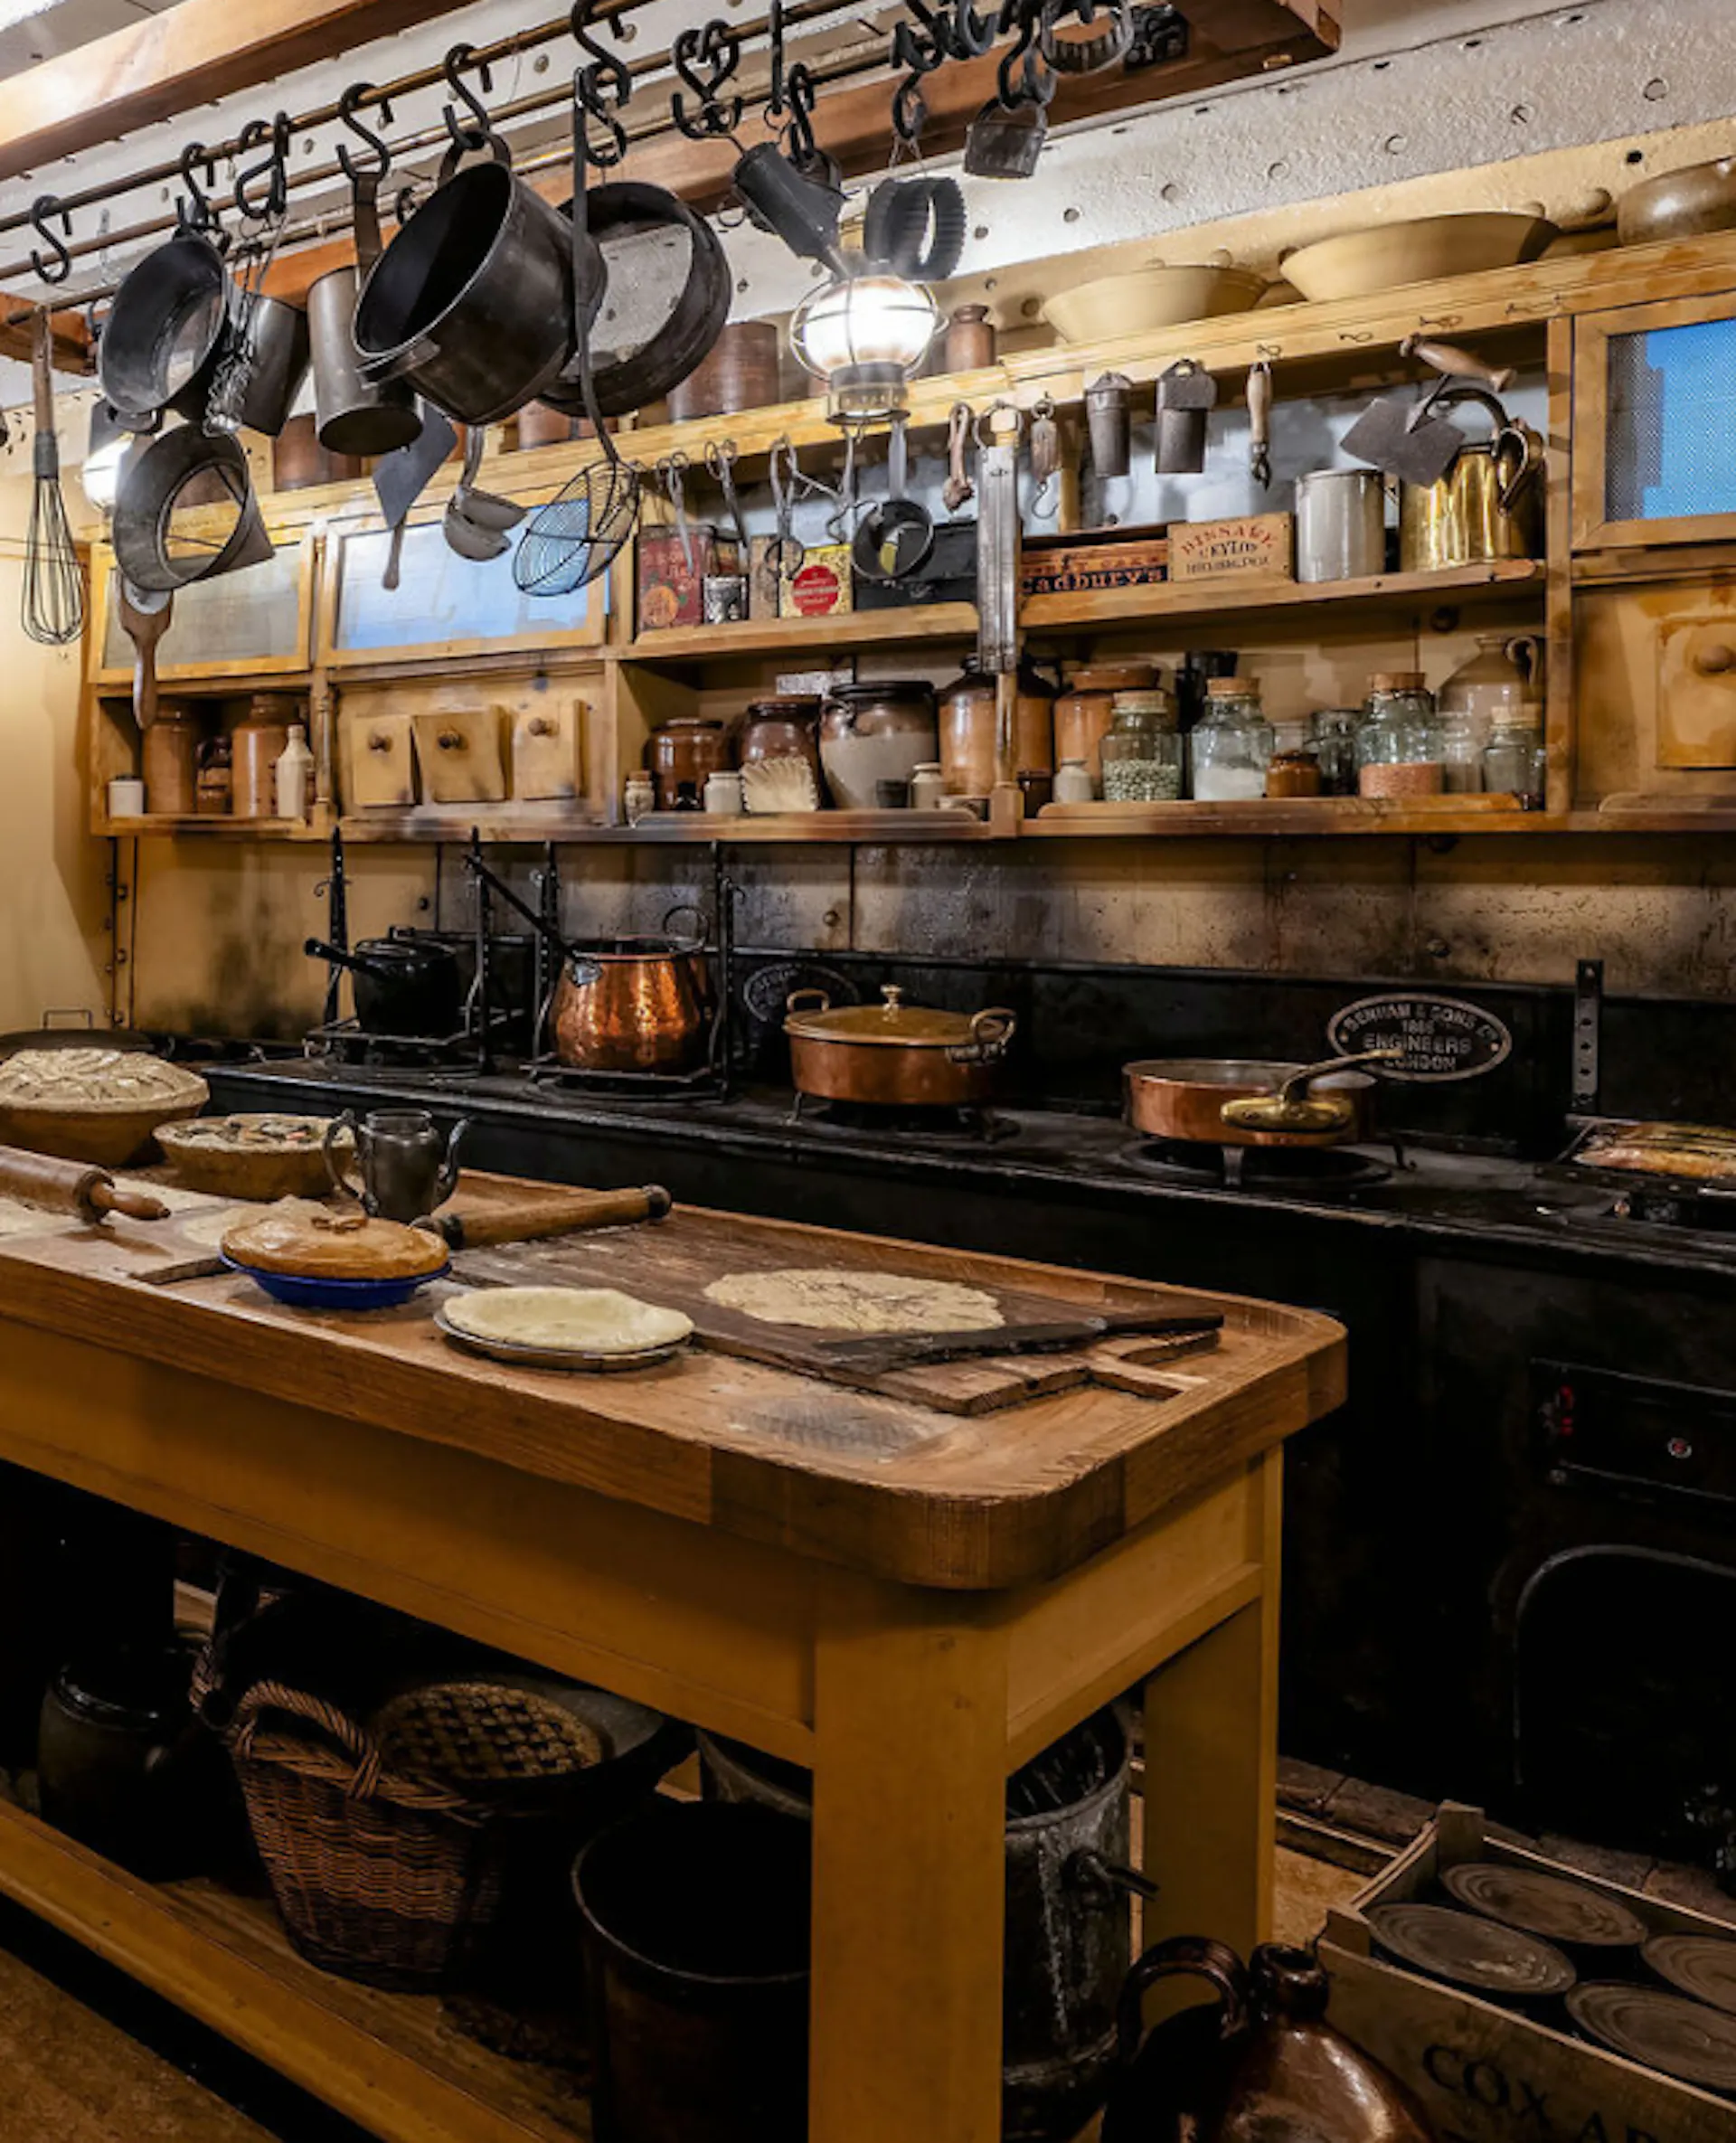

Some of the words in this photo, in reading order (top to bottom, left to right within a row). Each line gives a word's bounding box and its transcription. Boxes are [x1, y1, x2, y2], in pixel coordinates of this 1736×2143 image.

[1430, 1004, 1477, 1031] SONS
[1363, 1032, 1473, 1055] ENGINEERS
[1422, 2044, 1552, 2131] COX
